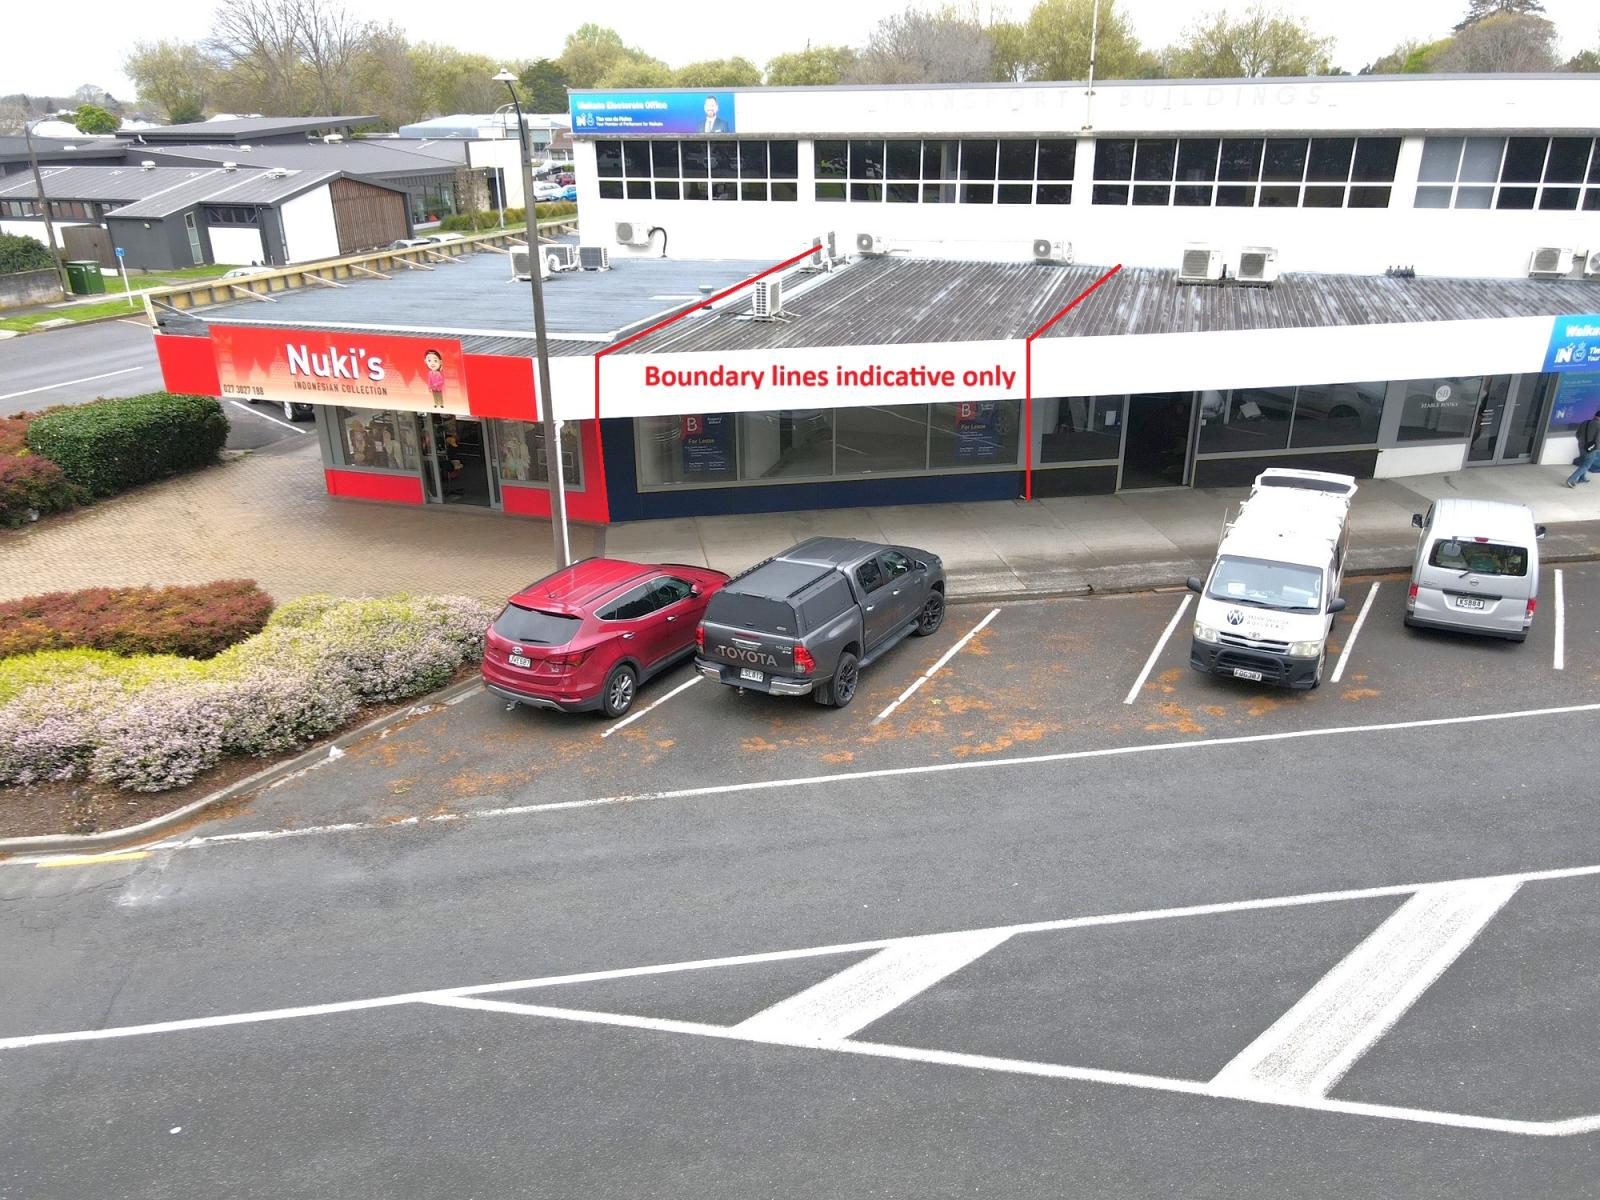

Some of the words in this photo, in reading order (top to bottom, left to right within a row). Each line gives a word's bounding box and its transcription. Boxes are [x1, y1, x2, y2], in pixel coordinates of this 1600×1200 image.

[1119, 85, 1322, 107] BUILDINGS
[286, 343, 385, 381] Nuki's
[294, 381, 339, 393] INDONESIAN
[342, 384, 388, 396] COLLECTION
[961, 403, 971, 417] B
[687, 417, 697, 431] B
[718, 645, 778, 667] TOYOTA
